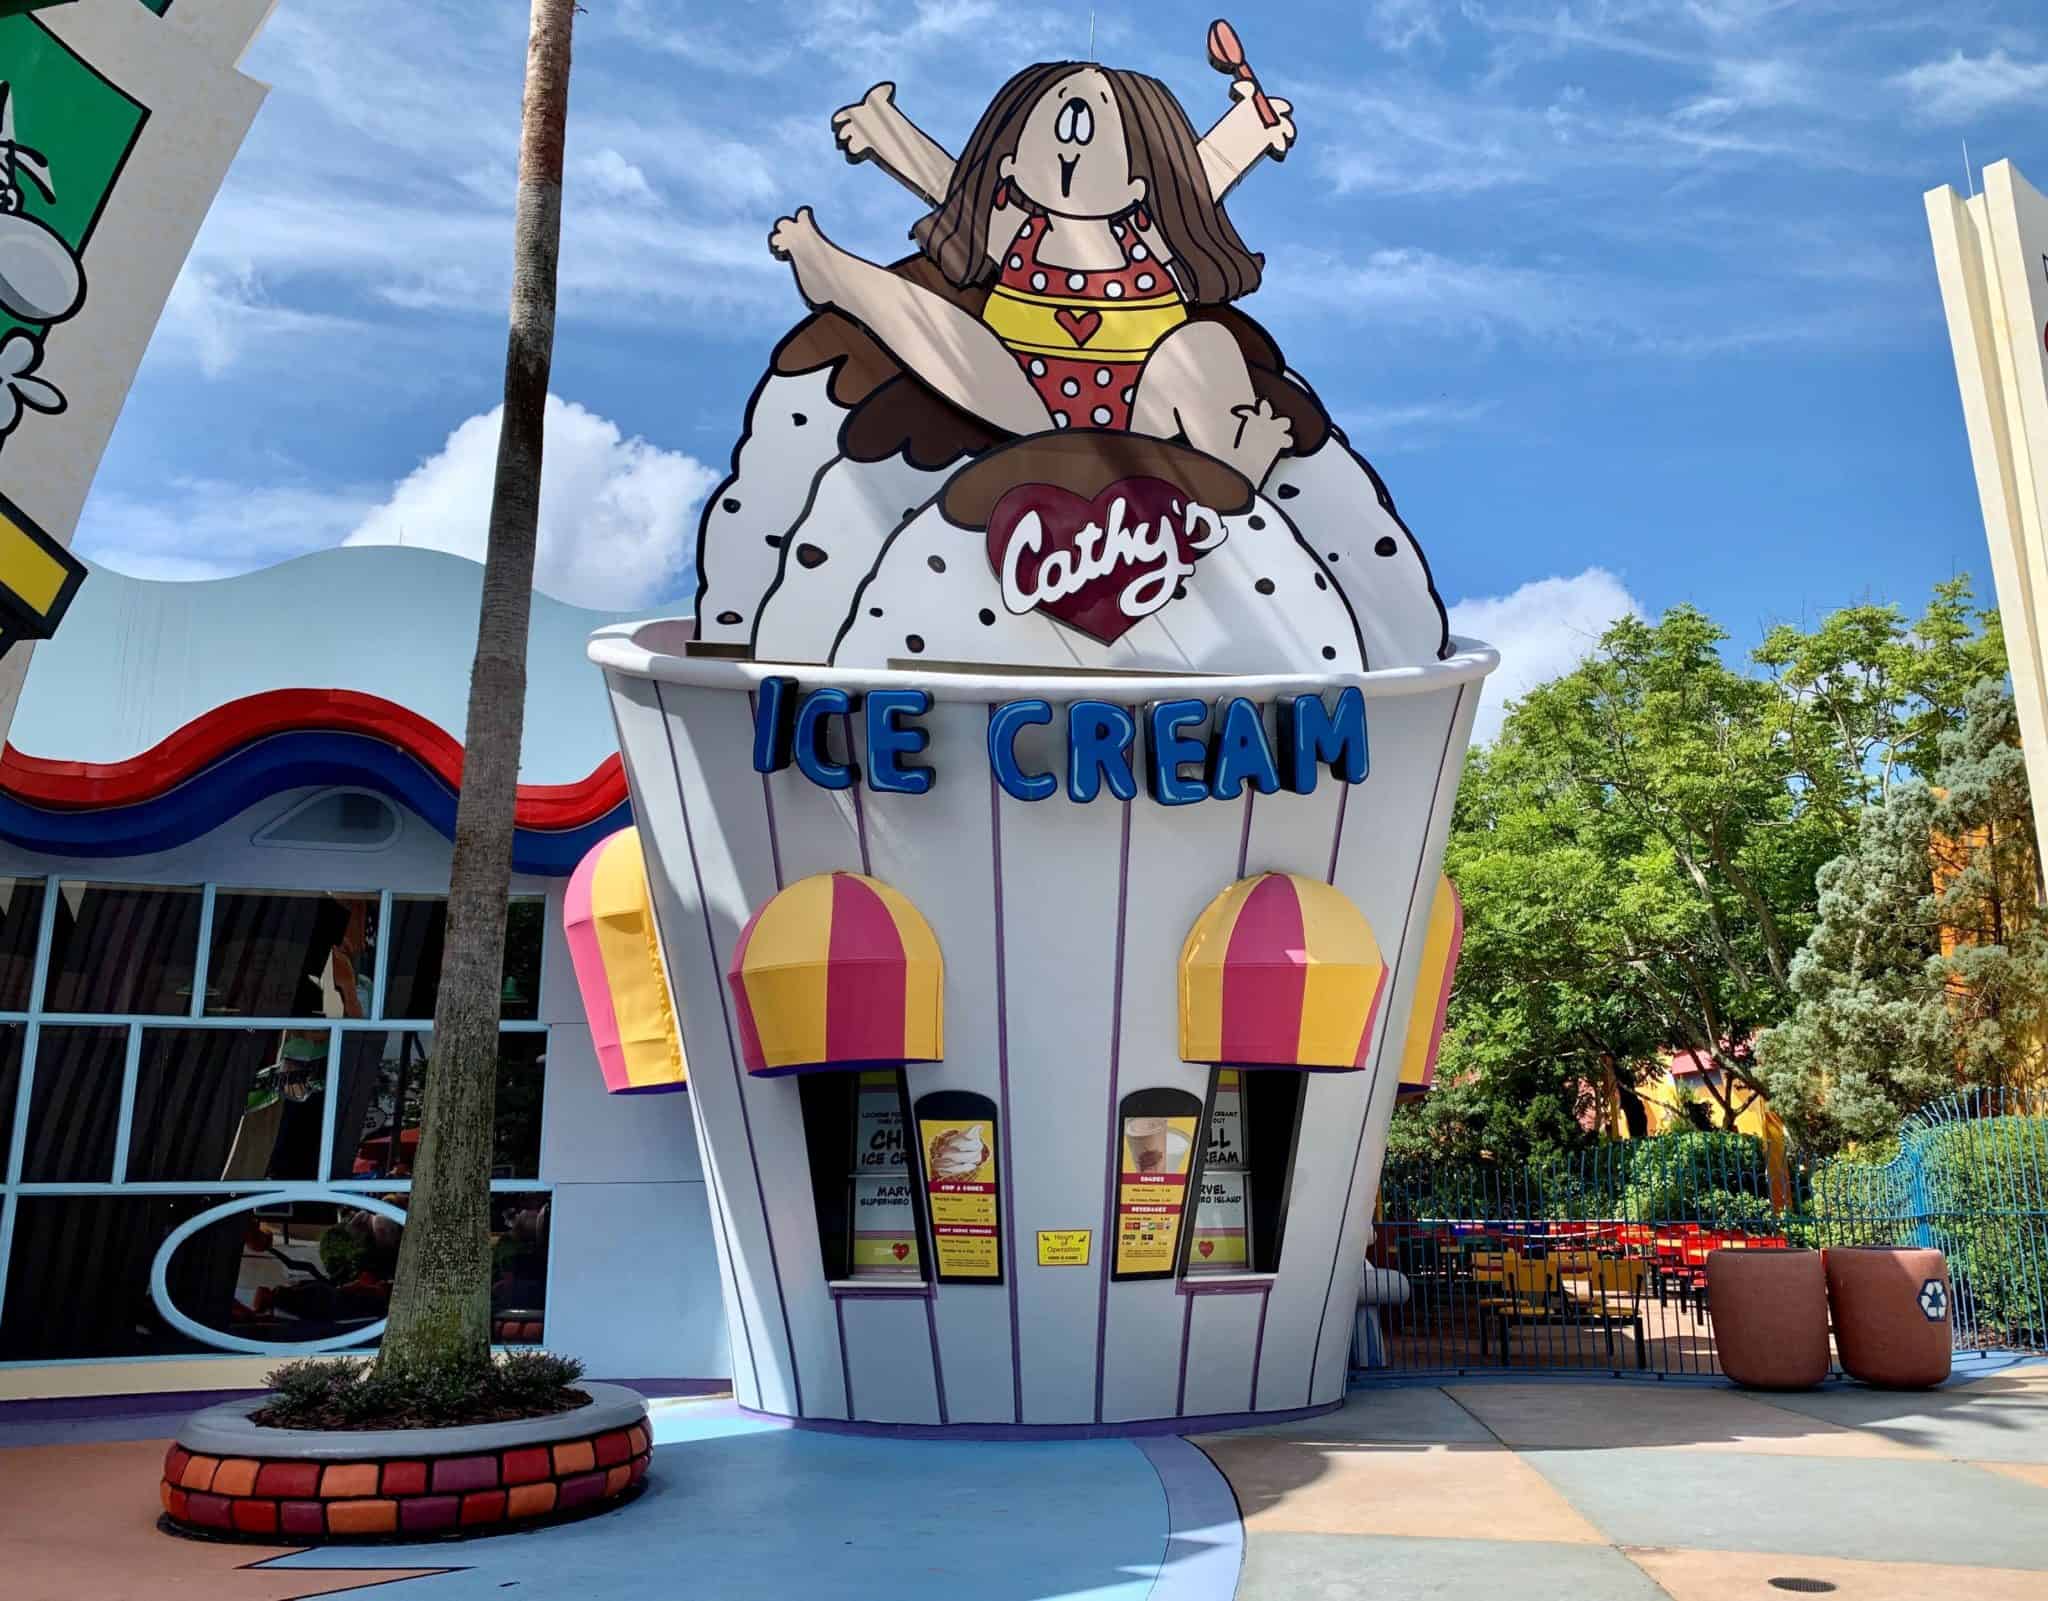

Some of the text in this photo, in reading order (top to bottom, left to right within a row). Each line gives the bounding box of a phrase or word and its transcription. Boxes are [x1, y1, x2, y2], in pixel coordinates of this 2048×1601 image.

[1000, 496, 1229, 617] Cathy's
[752, 676, 1370, 807] ICE CREAM
[861, 1151, 885, 1165] ICE
